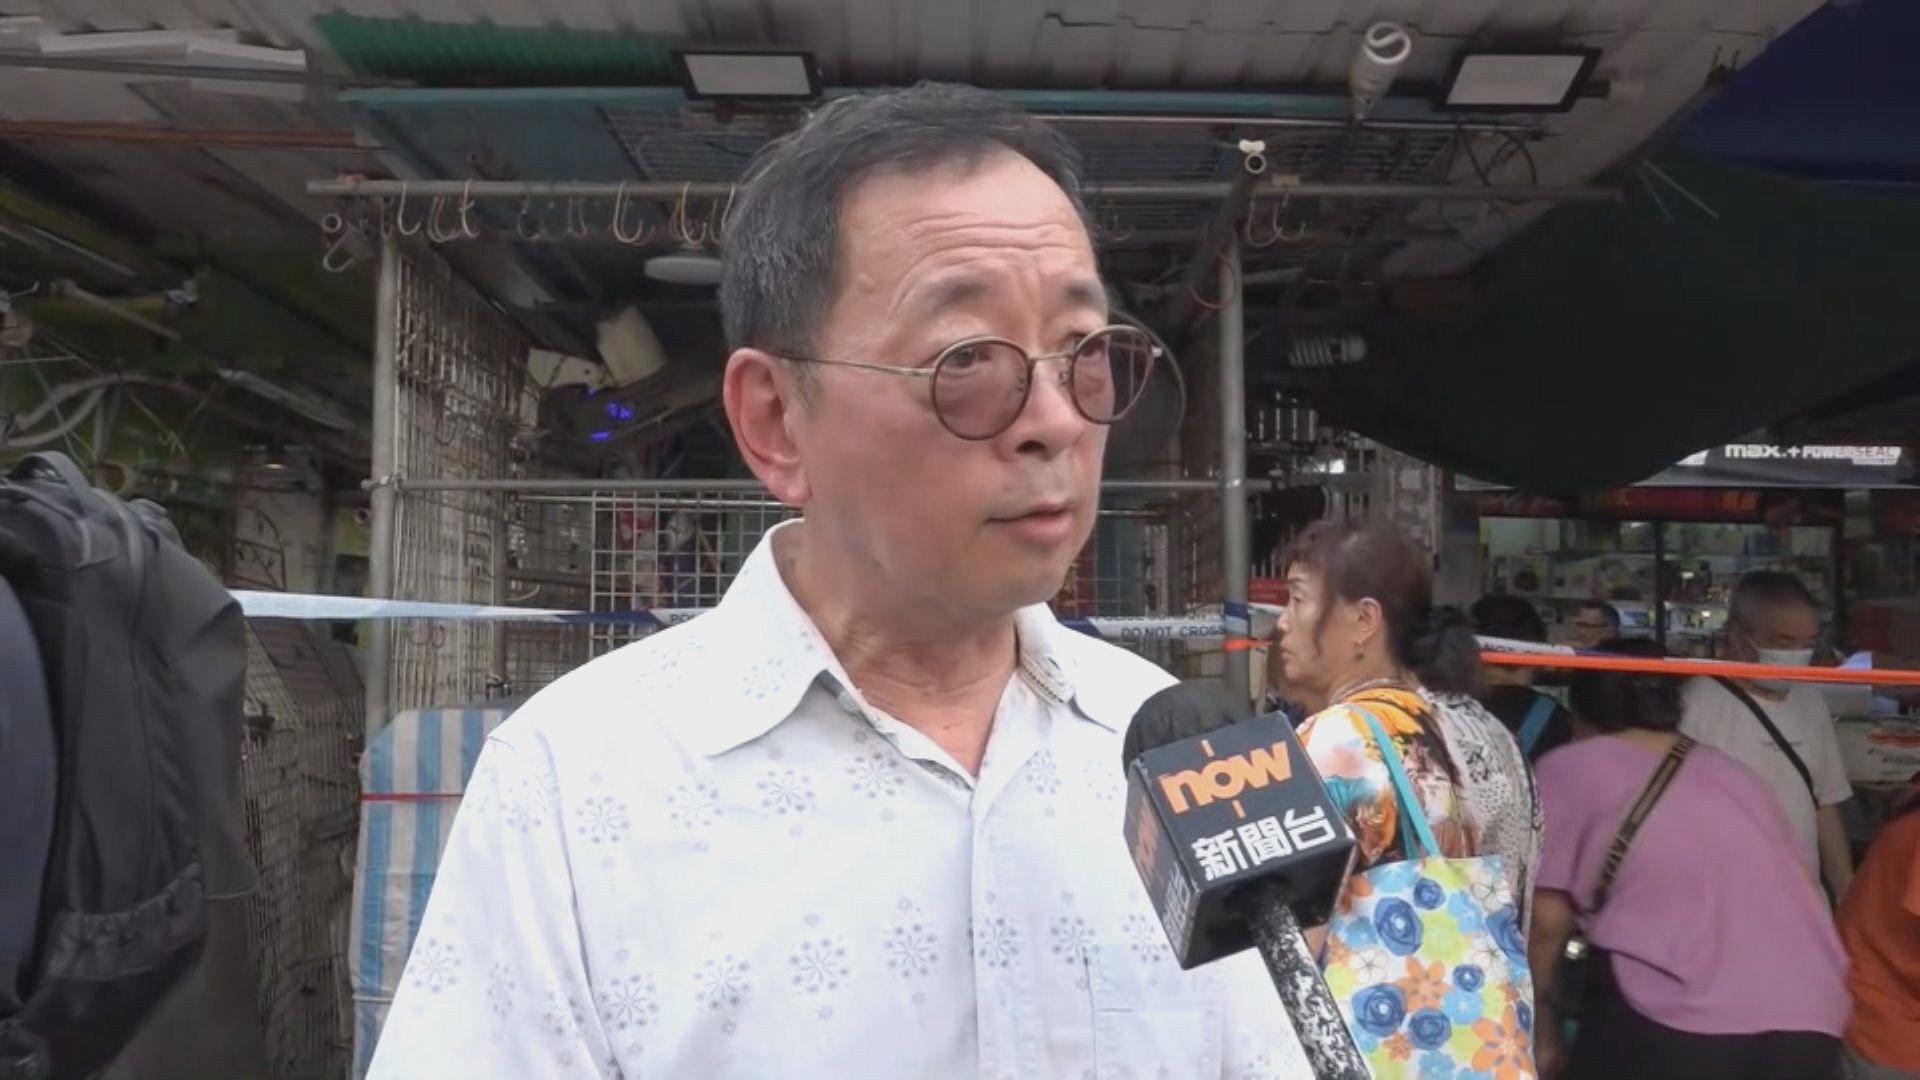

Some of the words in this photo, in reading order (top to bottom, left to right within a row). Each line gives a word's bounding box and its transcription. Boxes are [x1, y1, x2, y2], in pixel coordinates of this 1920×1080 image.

[1121, 627, 1142, 641] DO
[1144, 626, 1172, 640] NOT
[1157, 740, 1293, 815] now
[1190, 805, 1337, 881] 新聞台
